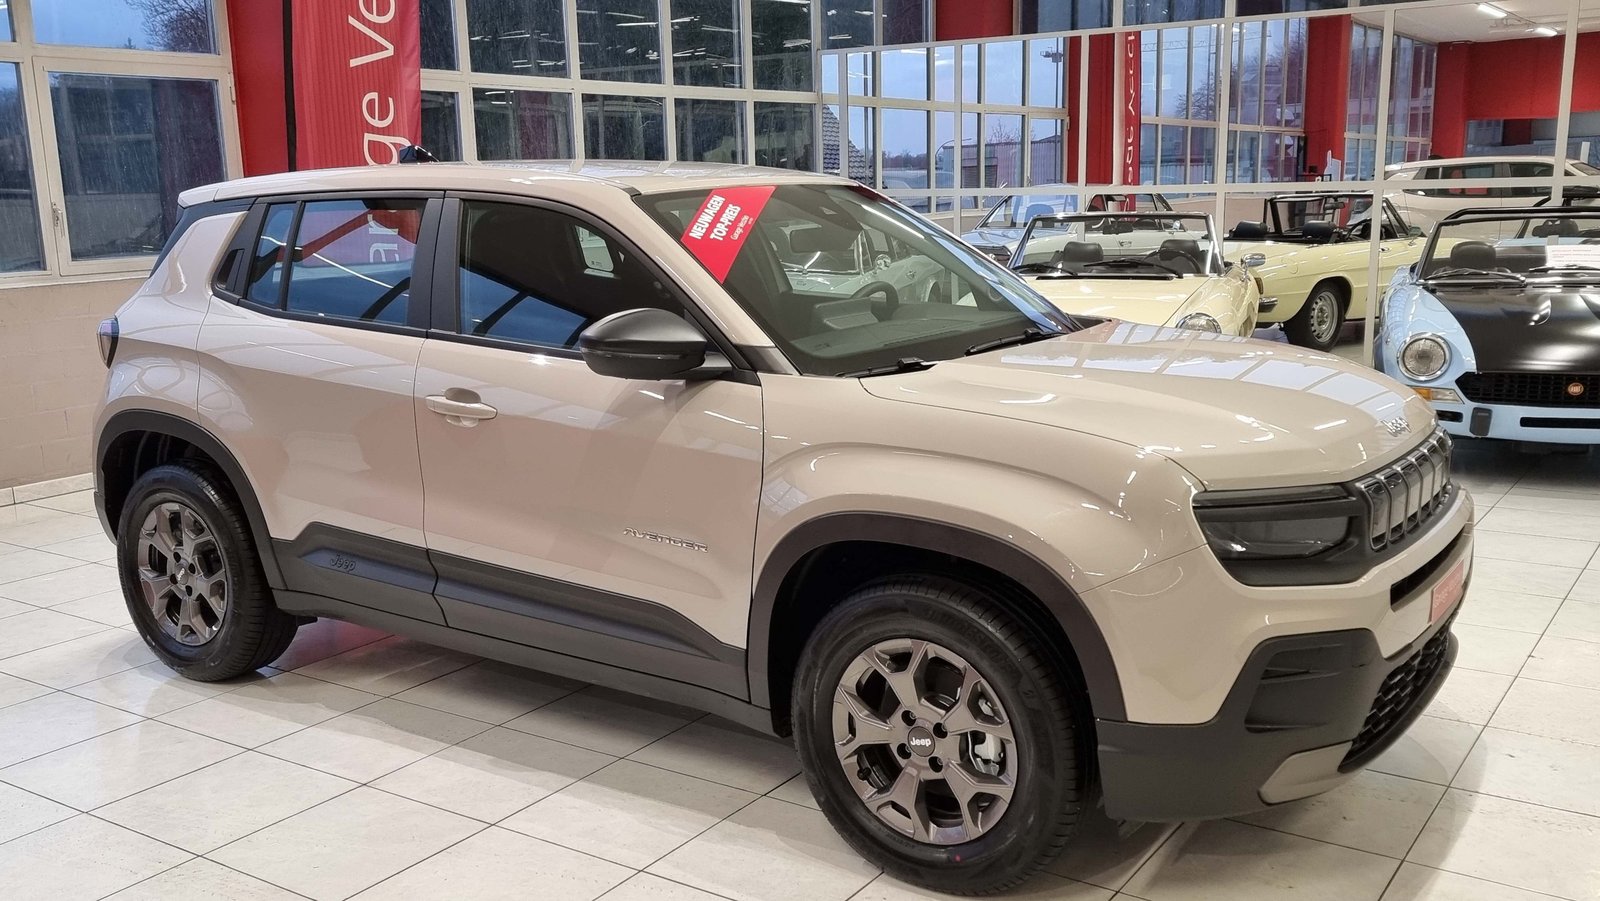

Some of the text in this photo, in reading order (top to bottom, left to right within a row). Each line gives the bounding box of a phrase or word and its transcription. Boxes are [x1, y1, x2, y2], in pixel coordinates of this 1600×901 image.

[689, 195, 726, 240] NEUWAGEN
[710, 203, 742, 241] TOP-PREIS
[623, 527, 708, 553] AVENGER
[330, 552, 357, 574] Jeep
[910, 737, 932, 747] Jeep
